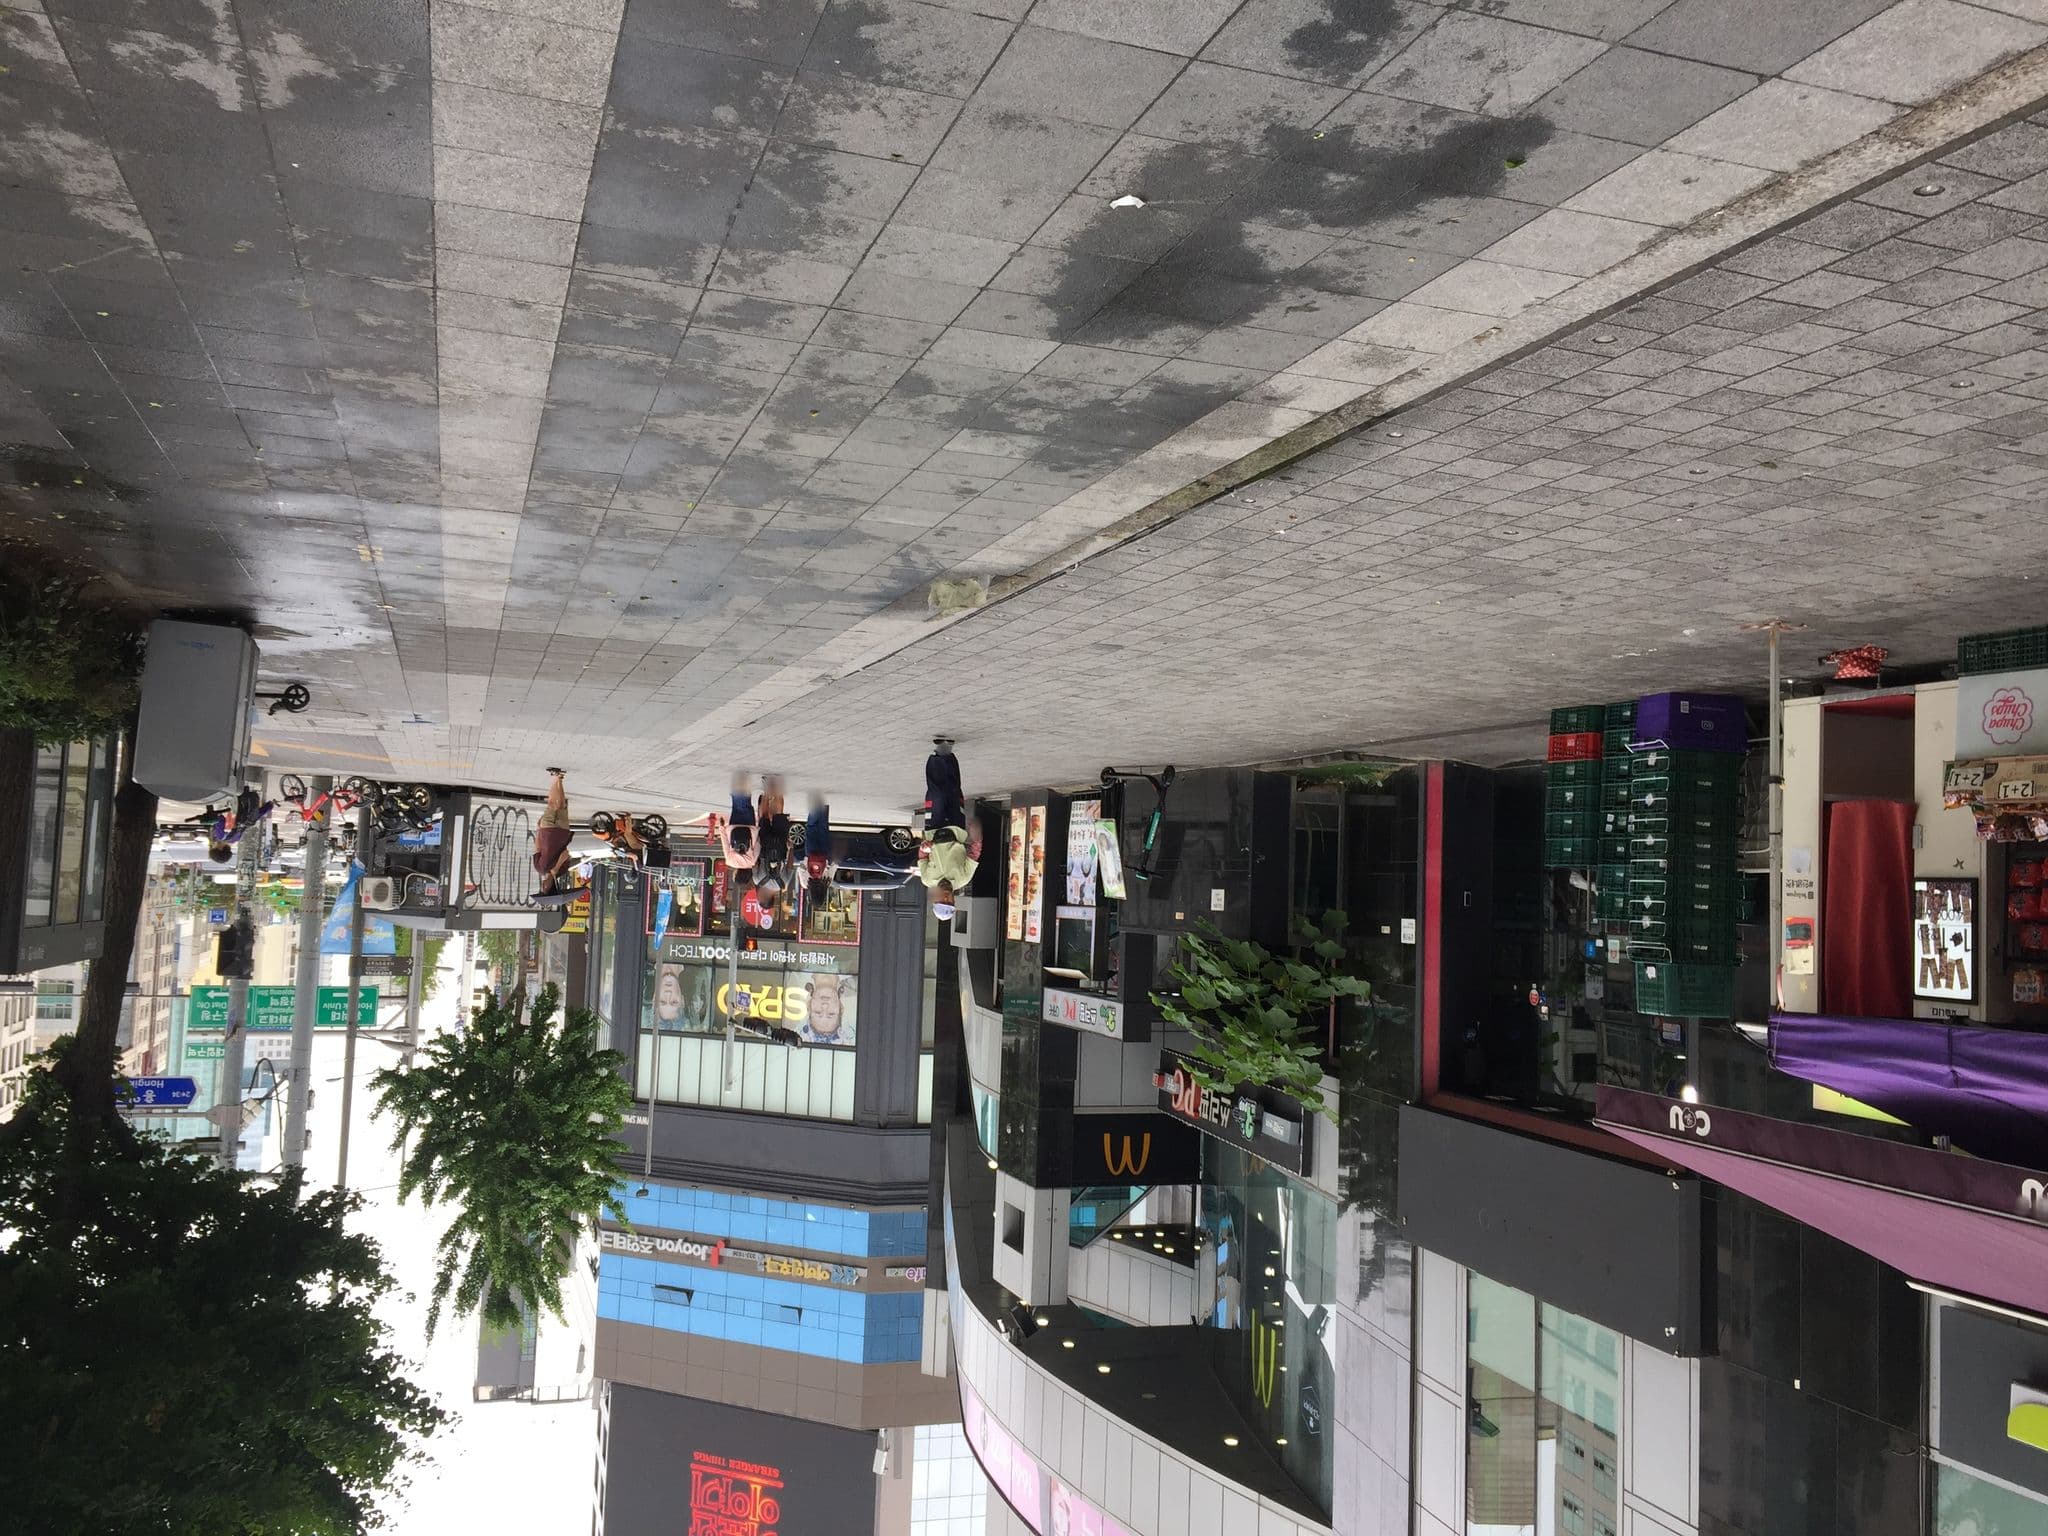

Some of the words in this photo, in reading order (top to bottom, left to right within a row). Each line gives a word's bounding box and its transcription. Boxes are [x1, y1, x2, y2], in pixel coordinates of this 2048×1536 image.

[1991, 700, 2028, 717] Chups
[1988, 716, 2025, 731] Chupa
[770, 950, 797, 963] 차원이
[799, 951, 835, 965] 시원함의
[600, 1230, 655, 1254] 주연테크
[655, 1238, 708, 1261] Jooyon
[692, 1451, 726, 1467] THINGS
[728, 1459, 780, 1478] STRANGER
[691, 1470, 780, 1525] 이야기
